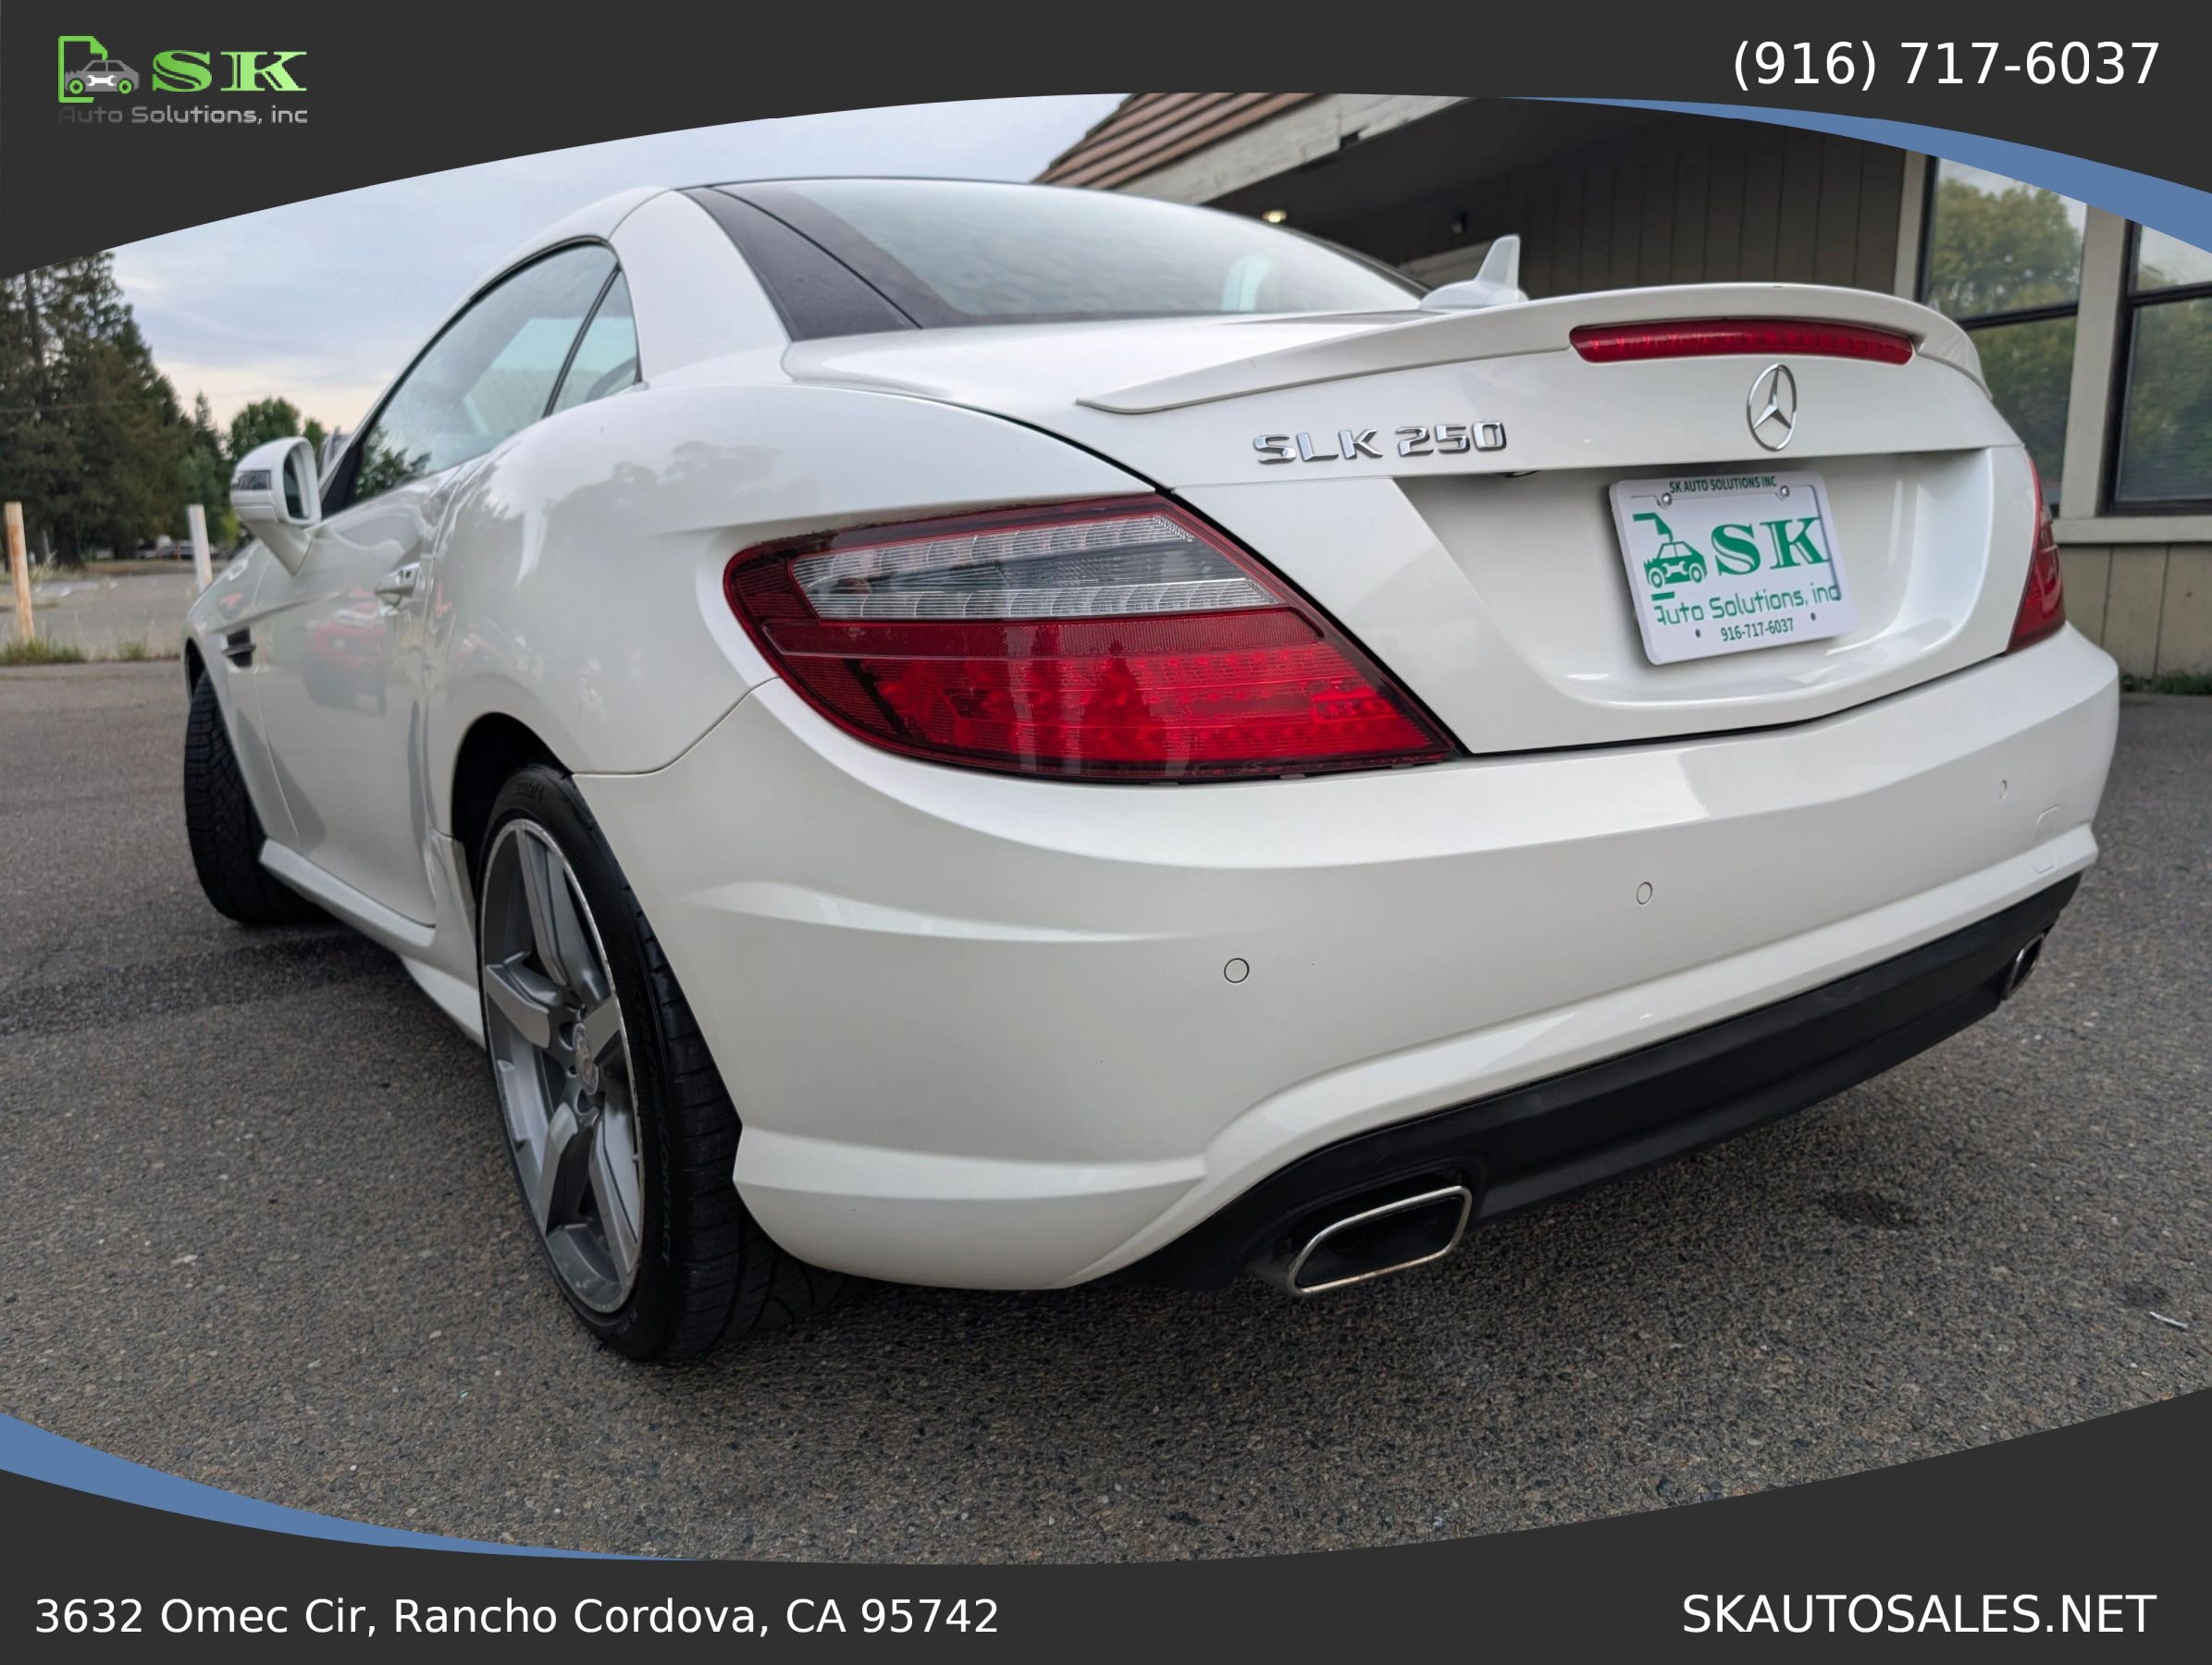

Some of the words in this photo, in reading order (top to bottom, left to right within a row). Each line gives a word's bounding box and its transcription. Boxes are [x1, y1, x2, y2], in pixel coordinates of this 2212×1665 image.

[1253, 428, 1383, 464] SLK
[1395, 421, 1507, 457] 250
[1669, 482, 1683, 493] SK
[1684, 479, 1709, 492] AUTO
[1711, 477, 1761, 491] SOLUTIONS
[1761, 475, 1776, 488] INC
[1712, 517, 1829, 575] SK
[1709, 589, 1809, 619] Solutions,
[1721, 617, 1795, 642] 916-717-6037
